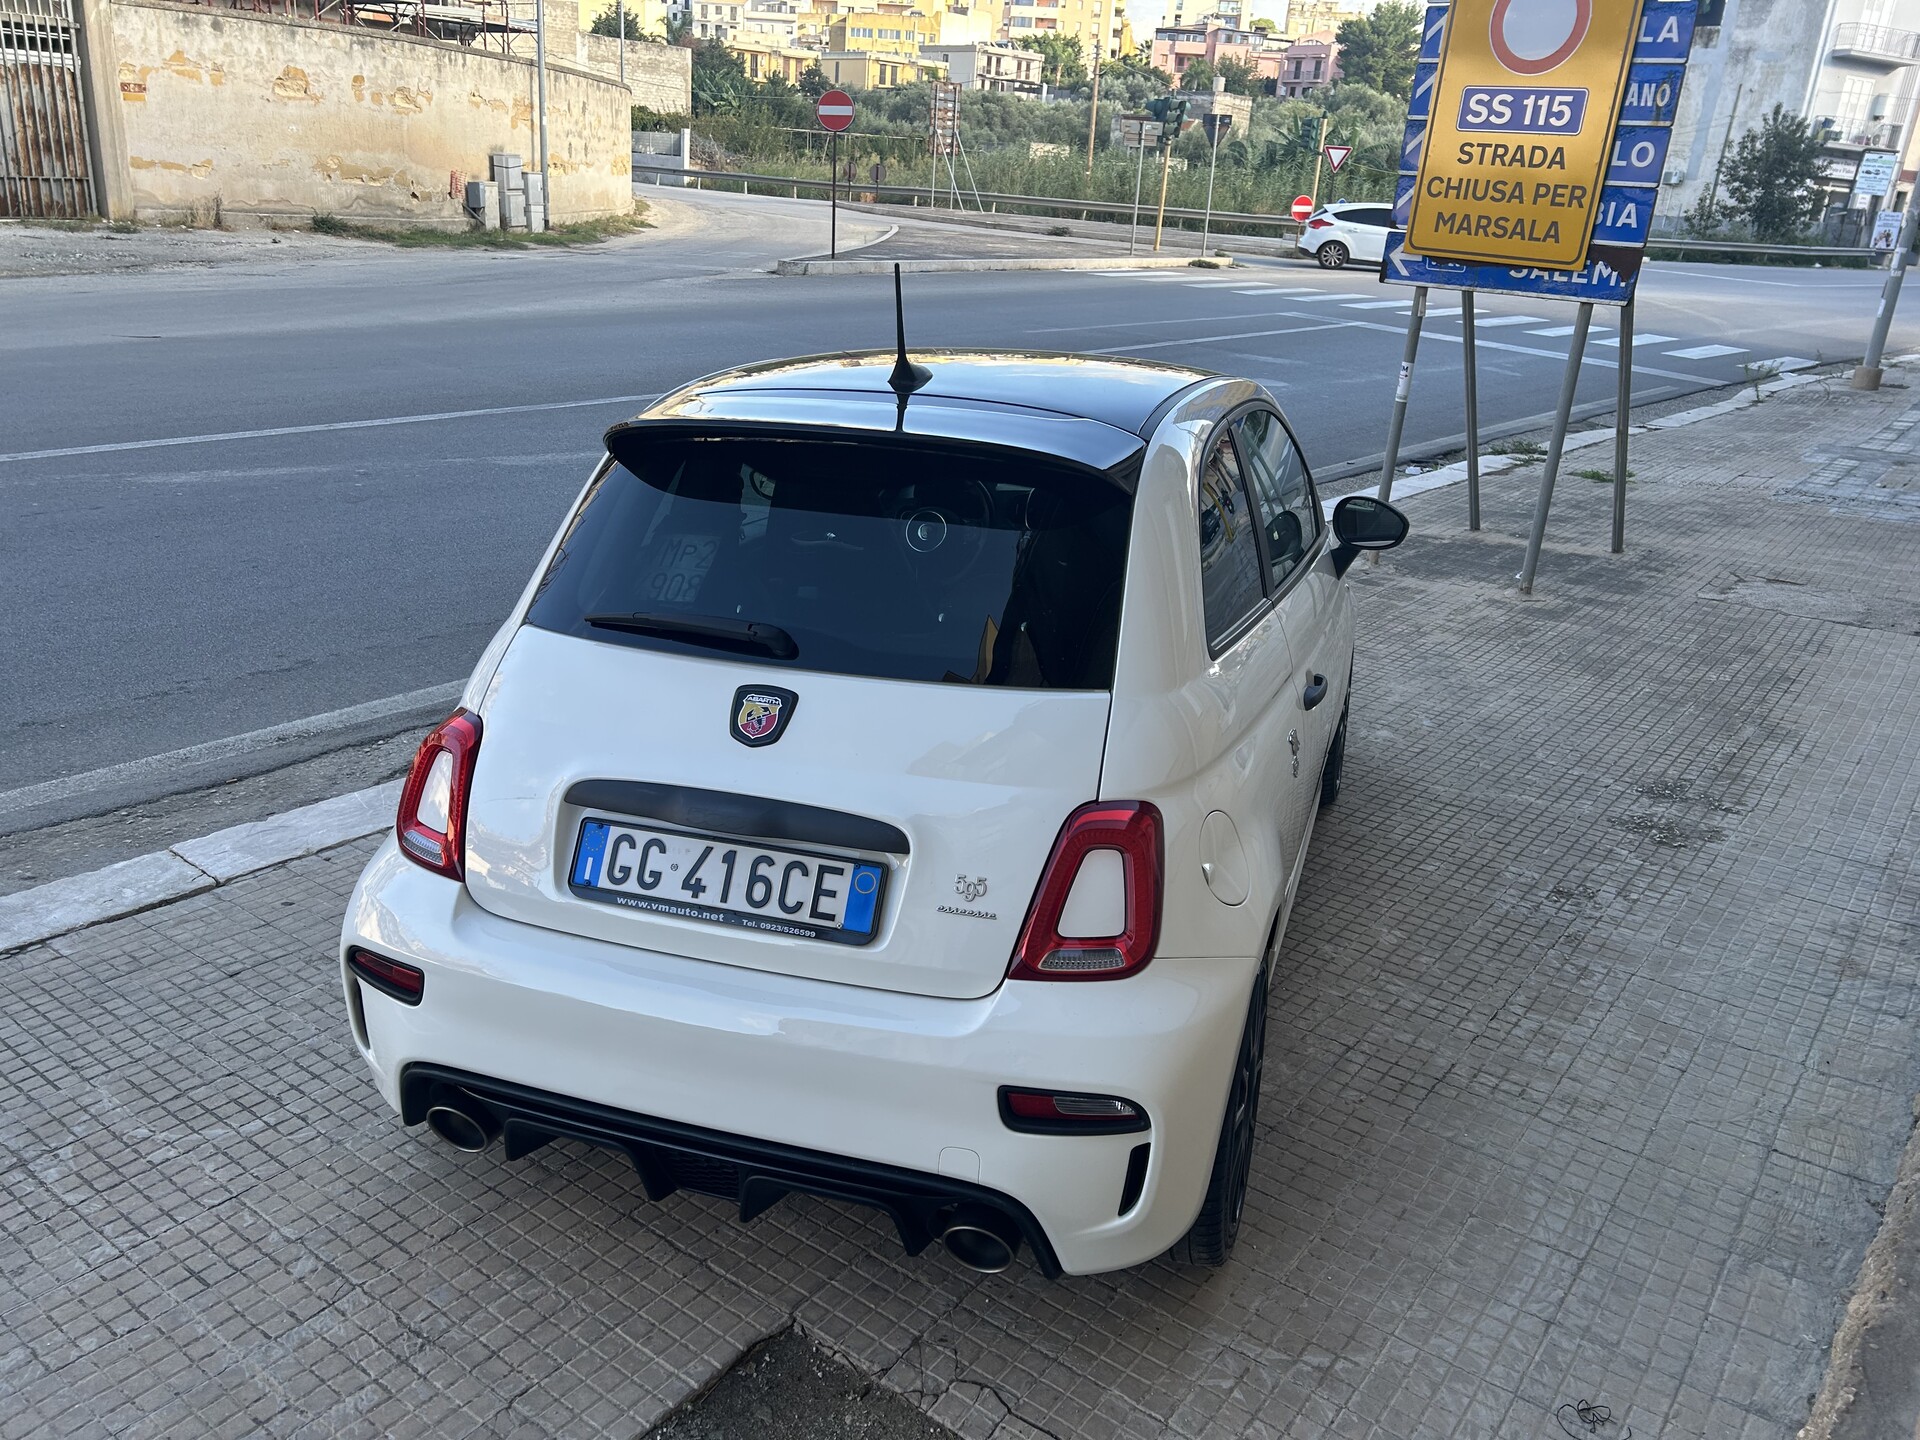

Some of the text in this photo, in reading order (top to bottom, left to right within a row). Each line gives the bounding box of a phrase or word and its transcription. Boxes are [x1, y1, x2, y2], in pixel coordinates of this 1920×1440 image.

[1466, 93, 1574, 127] SS 115
[1456, 142, 1567, 170] STRADA
[1426, 176, 1588, 209] CHIUSA PER
[1433, 211, 1561, 244] MARSALA
[747, 696, 779, 705] ABARTH
[606, 833, 667, 891] GG
[680, 845, 845, 922] 416CE
[953, 873, 987, 902] 595
[616, 896, 725, 922] www.vmauto.net
[742, 918, 758, 928] Tel.
[760, 922, 816, 938] 0923/526599
